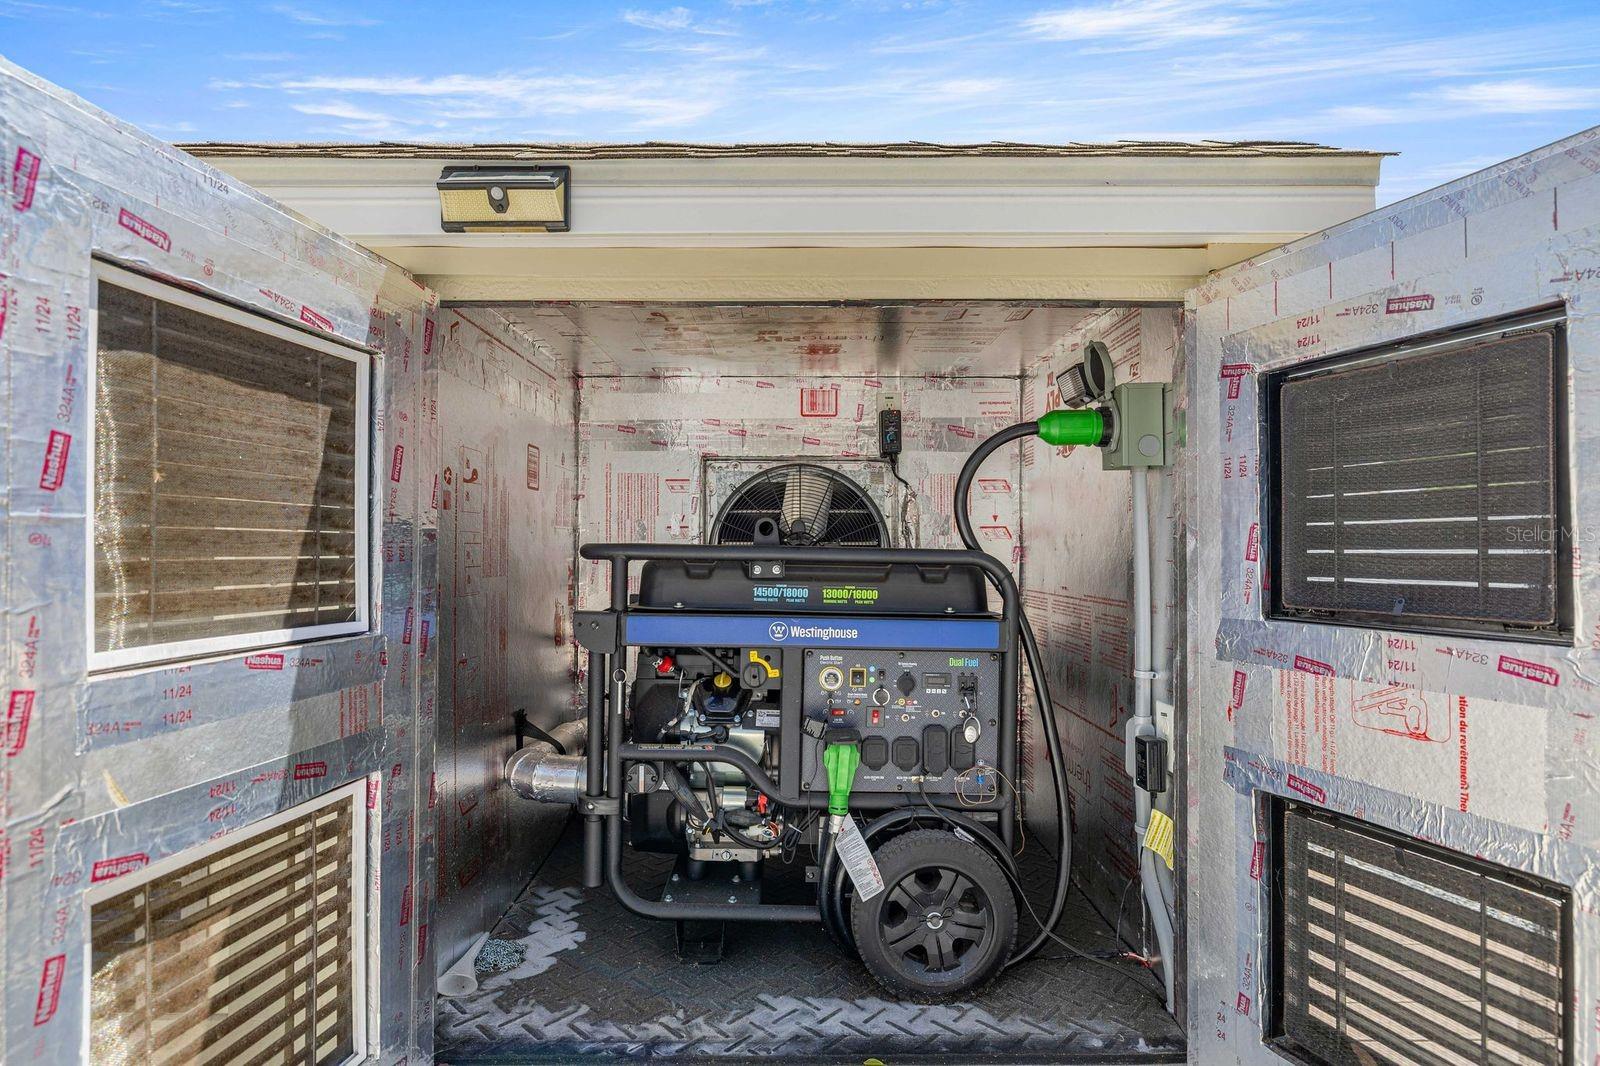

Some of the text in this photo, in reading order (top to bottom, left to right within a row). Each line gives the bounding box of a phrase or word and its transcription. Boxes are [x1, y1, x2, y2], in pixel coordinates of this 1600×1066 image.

[121, 213, 170, 249] Nashua
[273, 291, 296, 312] 324A
[1351, 303, 1380, 317] 324A
[1388, 298, 1433, 312] Nashua
[36, 296, 51, 334] 11/24
[67, 305, 82, 342] 11/24
[1296, 314, 1321, 330] 11/24
[1296, 333, 1321, 349] 11/24
[57, 385, 75, 424] 324A
[1227, 405, 1236, 430] 324A
[42, 433, 65, 490] Nashua
[1224, 457, 1232, 480] 11/24
[1240, 454, 1248, 479] 11/24
[753, 586, 809, 599] 14500/18000
[822, 589, 879, 601] 13000/16000
[790, 626, 858, 640] Westinghouse
[1386, 638, 1416, 651] 11/24
[20, 638, 39, 680] 324A
[246, 655, 312, 668] Nashua 324A
[949, 657, 979, 667] Dual Fuel
[1264, 650, 1290, 664] 324A
[1455, 648, 1489, 665] 324A
[1296, 660, 1332, 677] Nashua
[1387, 659, 1417, 673] 11/24
[1501, 661, 1557, 685] Nashua
[163, 684, 193, 700] 11/24
[163, 709, 193, 726] 11/24
[1460, 720, 1469, 732] du
[86, 722, 121, 737] 324A
[295, 765, 326, 778] Nashua
[208, 779, 238, 799] 11/24
[1289, 779, 1325, 803] Nashua
[28, 827, 44, 868] 11/24
[95, 857, 146, 878] Nashua
[53, 903, 71, 946] 324A
[1242, 967, 1252, 991] 324A
